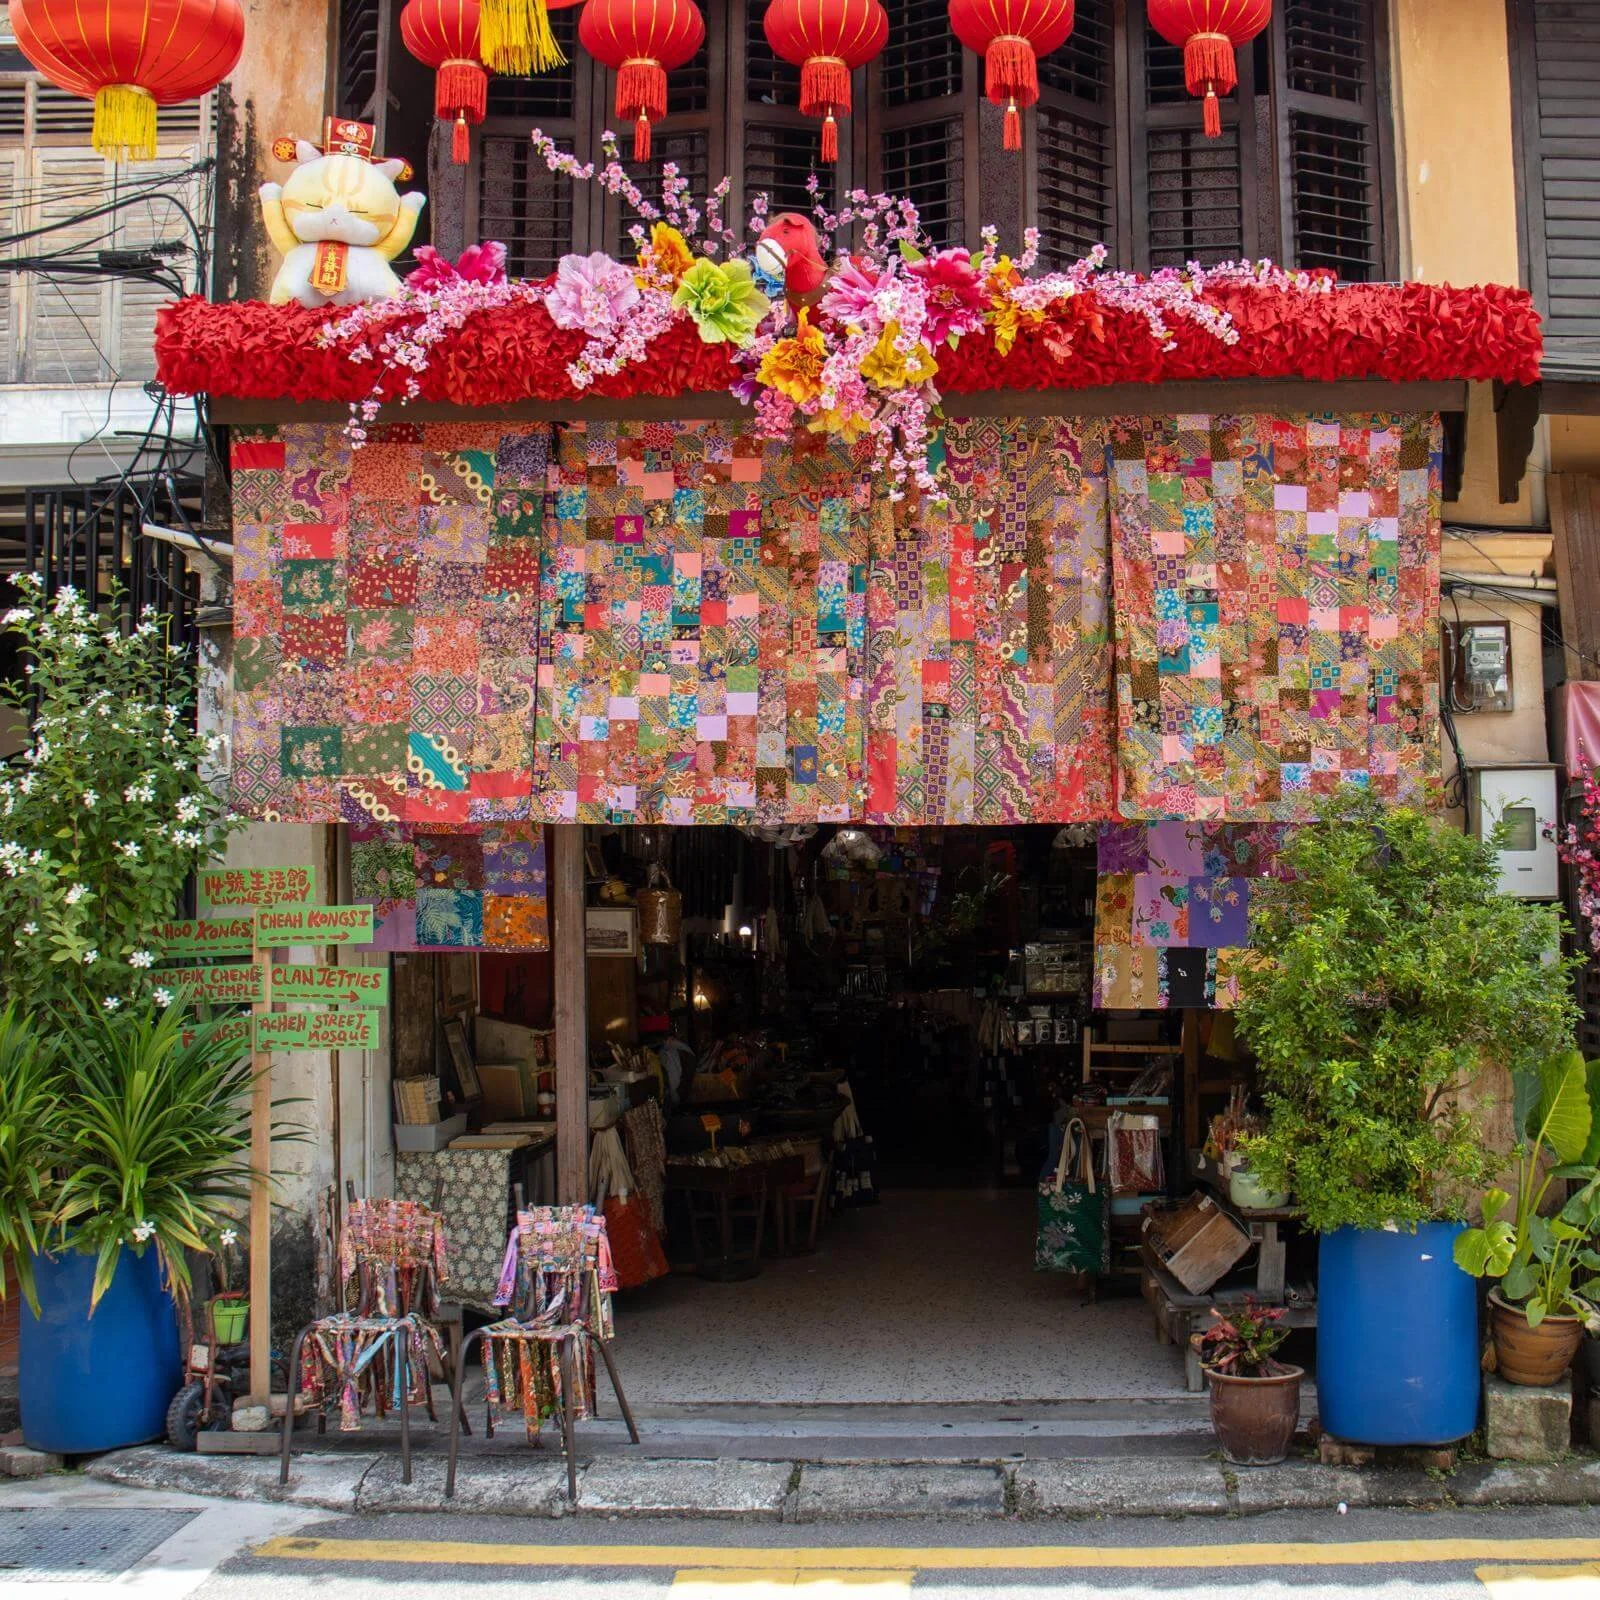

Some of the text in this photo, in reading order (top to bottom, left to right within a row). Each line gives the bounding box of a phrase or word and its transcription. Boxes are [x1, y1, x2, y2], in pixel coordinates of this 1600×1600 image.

[263, 883, 311, 903] STORY
[260, 910, 371, 930] CHEAH KONGSI
[271, 967, 382, 989] CLAN JETTIES
[204, 983, 260, 998] TEMPLE
[259, 1013, 366, 1033] ACHEH STREET
[308, 1025, 371, 1043] MOSQUE
